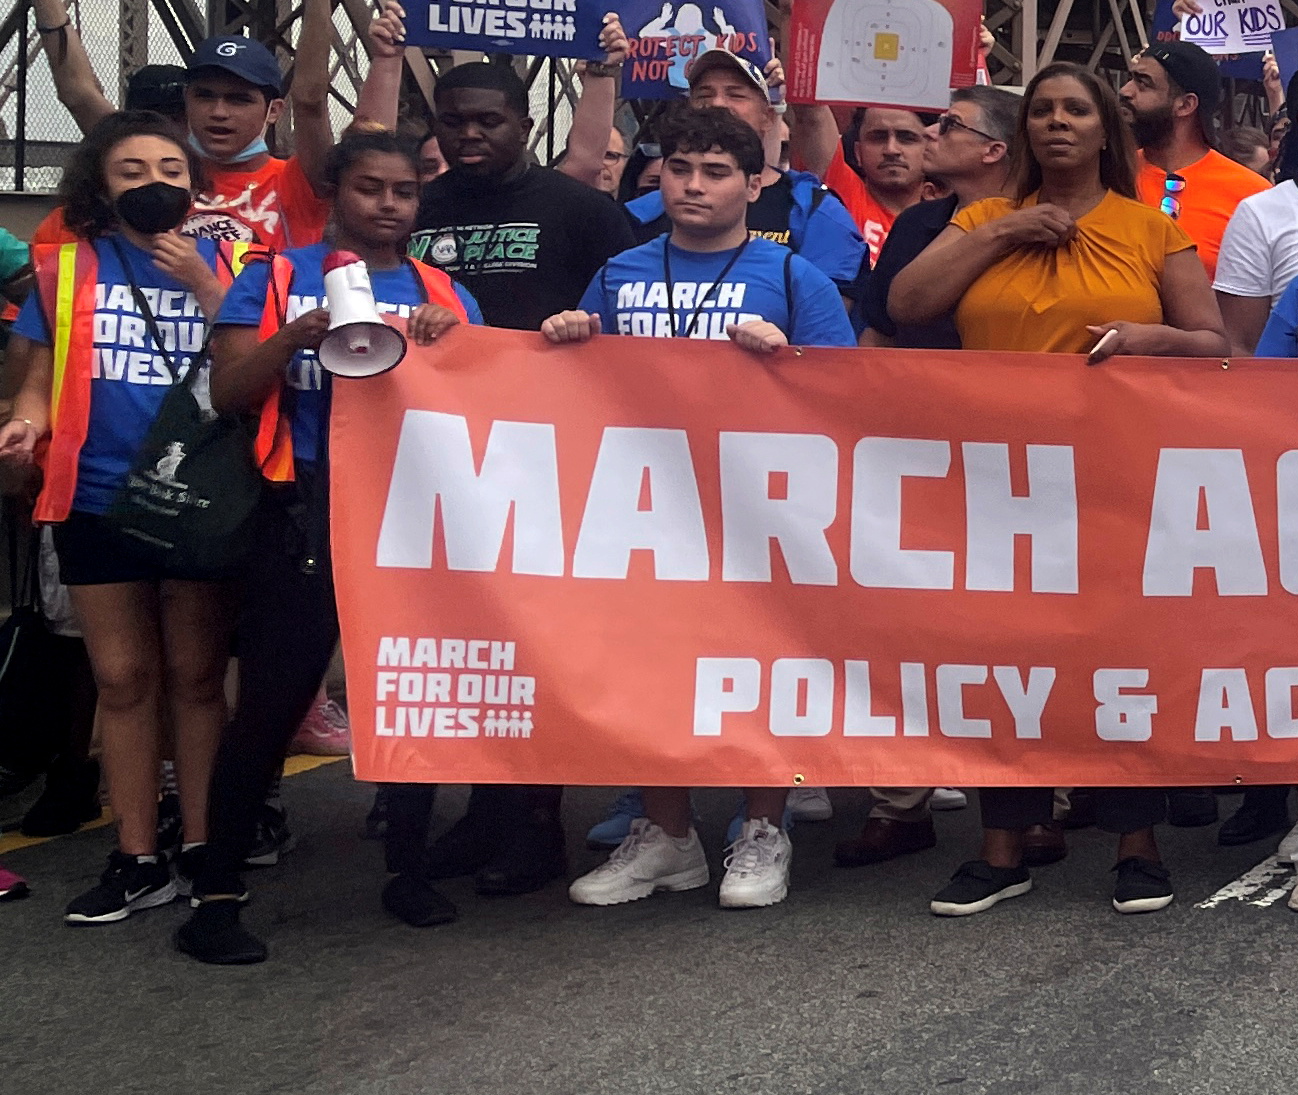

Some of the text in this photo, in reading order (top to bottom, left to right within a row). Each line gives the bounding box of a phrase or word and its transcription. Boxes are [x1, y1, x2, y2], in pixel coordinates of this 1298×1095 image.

[429, 3, 526, 39] LIVES
[1186, 5, 1281, 37] OUR KIDS
[626, 34, 705, 59] ROTECT
[632, 60, 674, 82] NOT
[617, 282, 746, 309] MARCH
[93, 313, 146, 347] OR
[92, 348, 173, 385] IVES
[375, 408, 1080, 597] MARCH
[375, 636, 515, 672] MARCH
[375, 671, 536, 707] FOR OUR
[692, 657, 1055, 739] POLICY
[1093, 667, 1158, 743] &
[375, 705, 481, 739] LIVES
